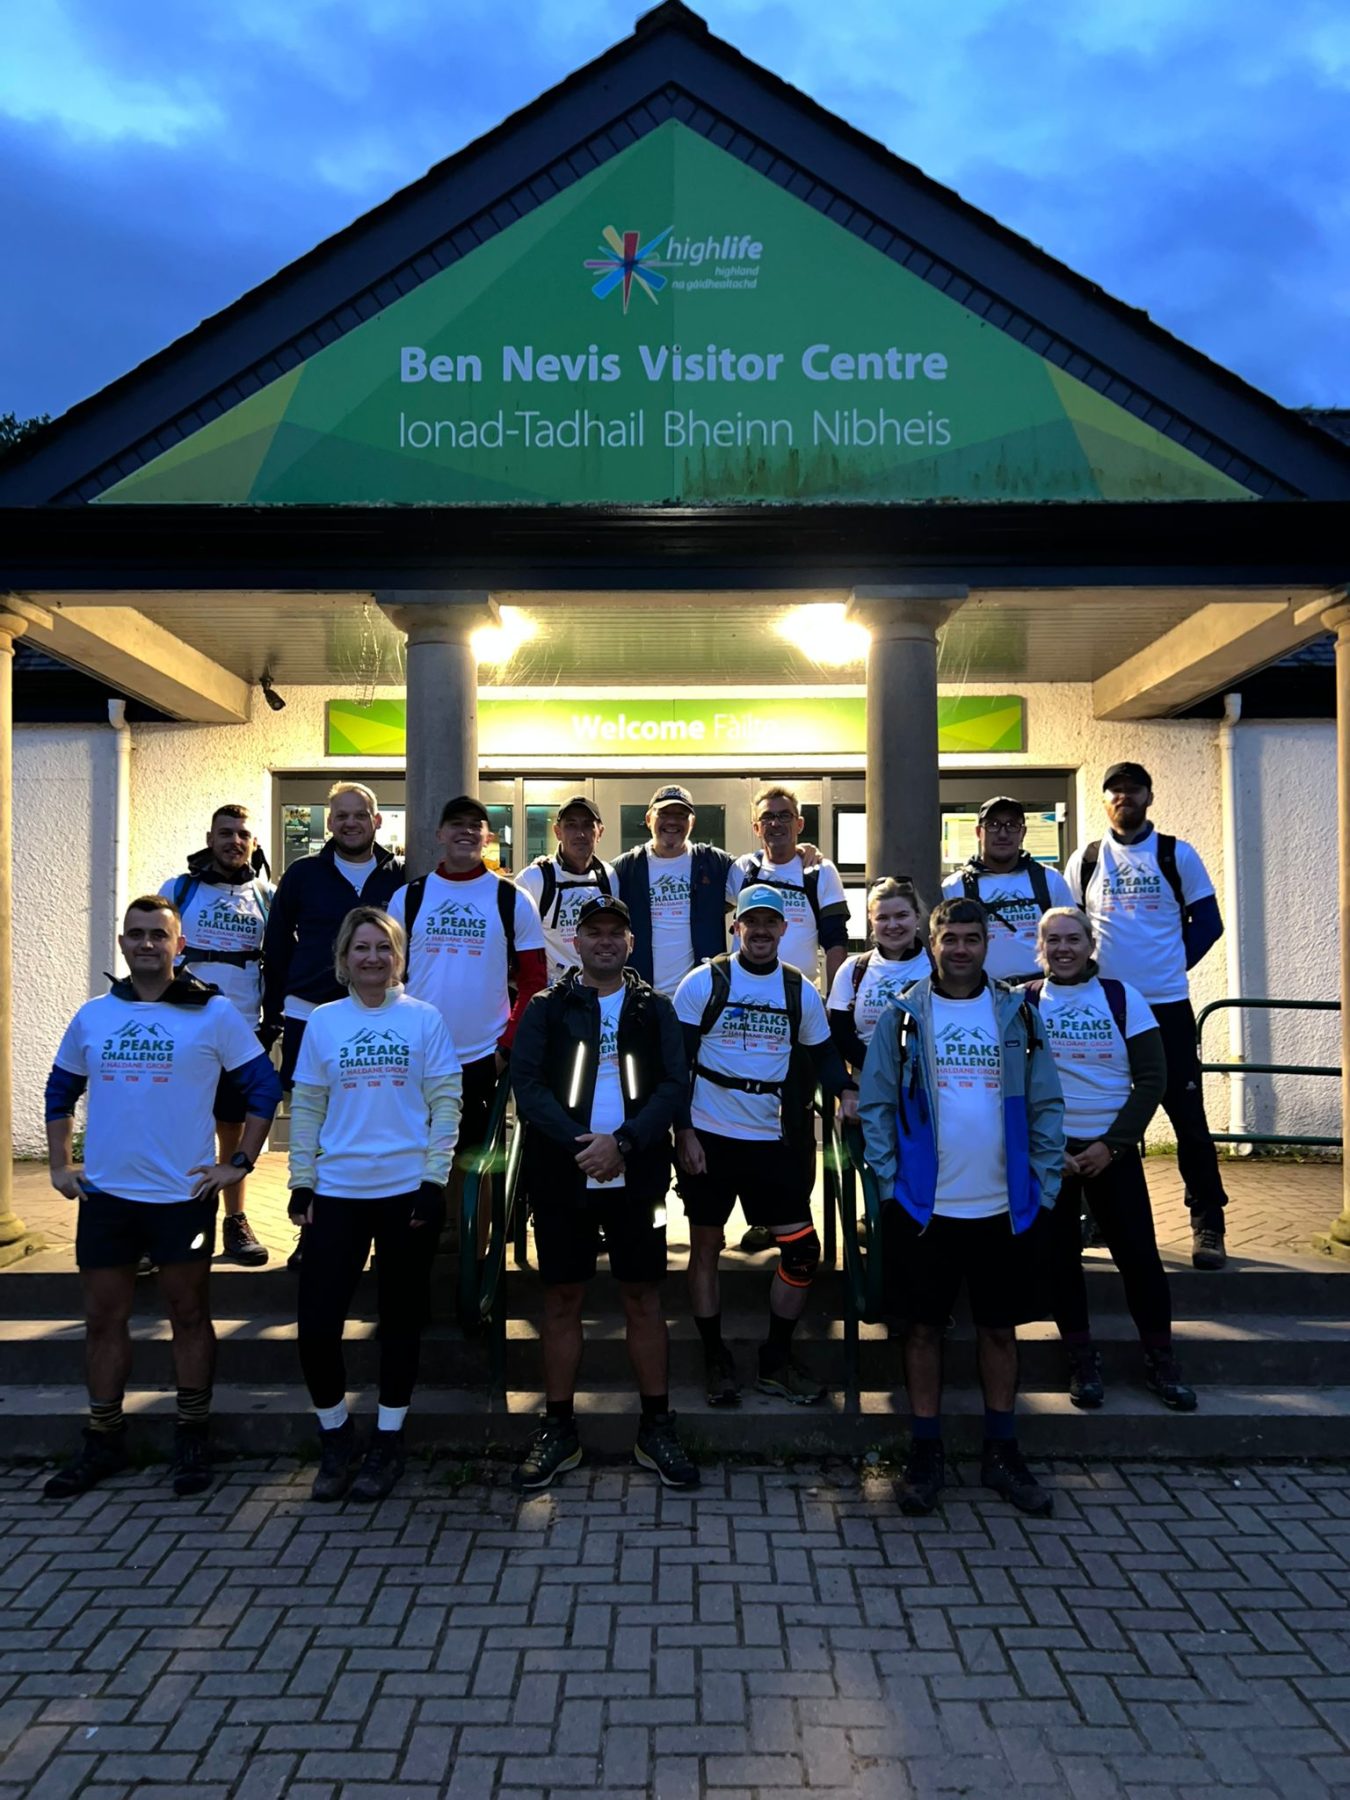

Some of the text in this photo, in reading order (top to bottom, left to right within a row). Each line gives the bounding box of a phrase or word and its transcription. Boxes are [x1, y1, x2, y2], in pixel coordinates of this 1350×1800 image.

[666, 235, 763, 267] highlife
[715, 266, 760, 278] highland
[672, 280, 685, 289] na
[400, 344, 949, 382] Ben Nevis Visitor Centre
[399, 409, 952, 448] Ionad-Tadhail Bheinn Nibheis
[571, 714, 705, 741] Welcome
[1103, 876, 1160, 887] 3 PEAKS
[1103, 886, 1160, 895] CHALLENGE
[199, 910, 257, 926] 3 PEAKS
[560, 910, 567, 918] 3
[198, 920, 257, 934] CHALLENGE
[427, 917, 486, 929] 3 PEAKS
[426, 928, 485, 938] CHALLENGE
[740, 1012, 788, 1026] PEAKS
[1046, 1019, 1111, 1030] 3 PEAKS
[722, 1021, 787, 1036] CHALLENGE
[103, 1039, 175, 1051] 3 PEAKS
[340, 1044, 409, 1058] 3 PEAKS
[101, 1051, 173, 1061] CHALLENGE
[340, 1056, 409, 1068] CHALLENGE
